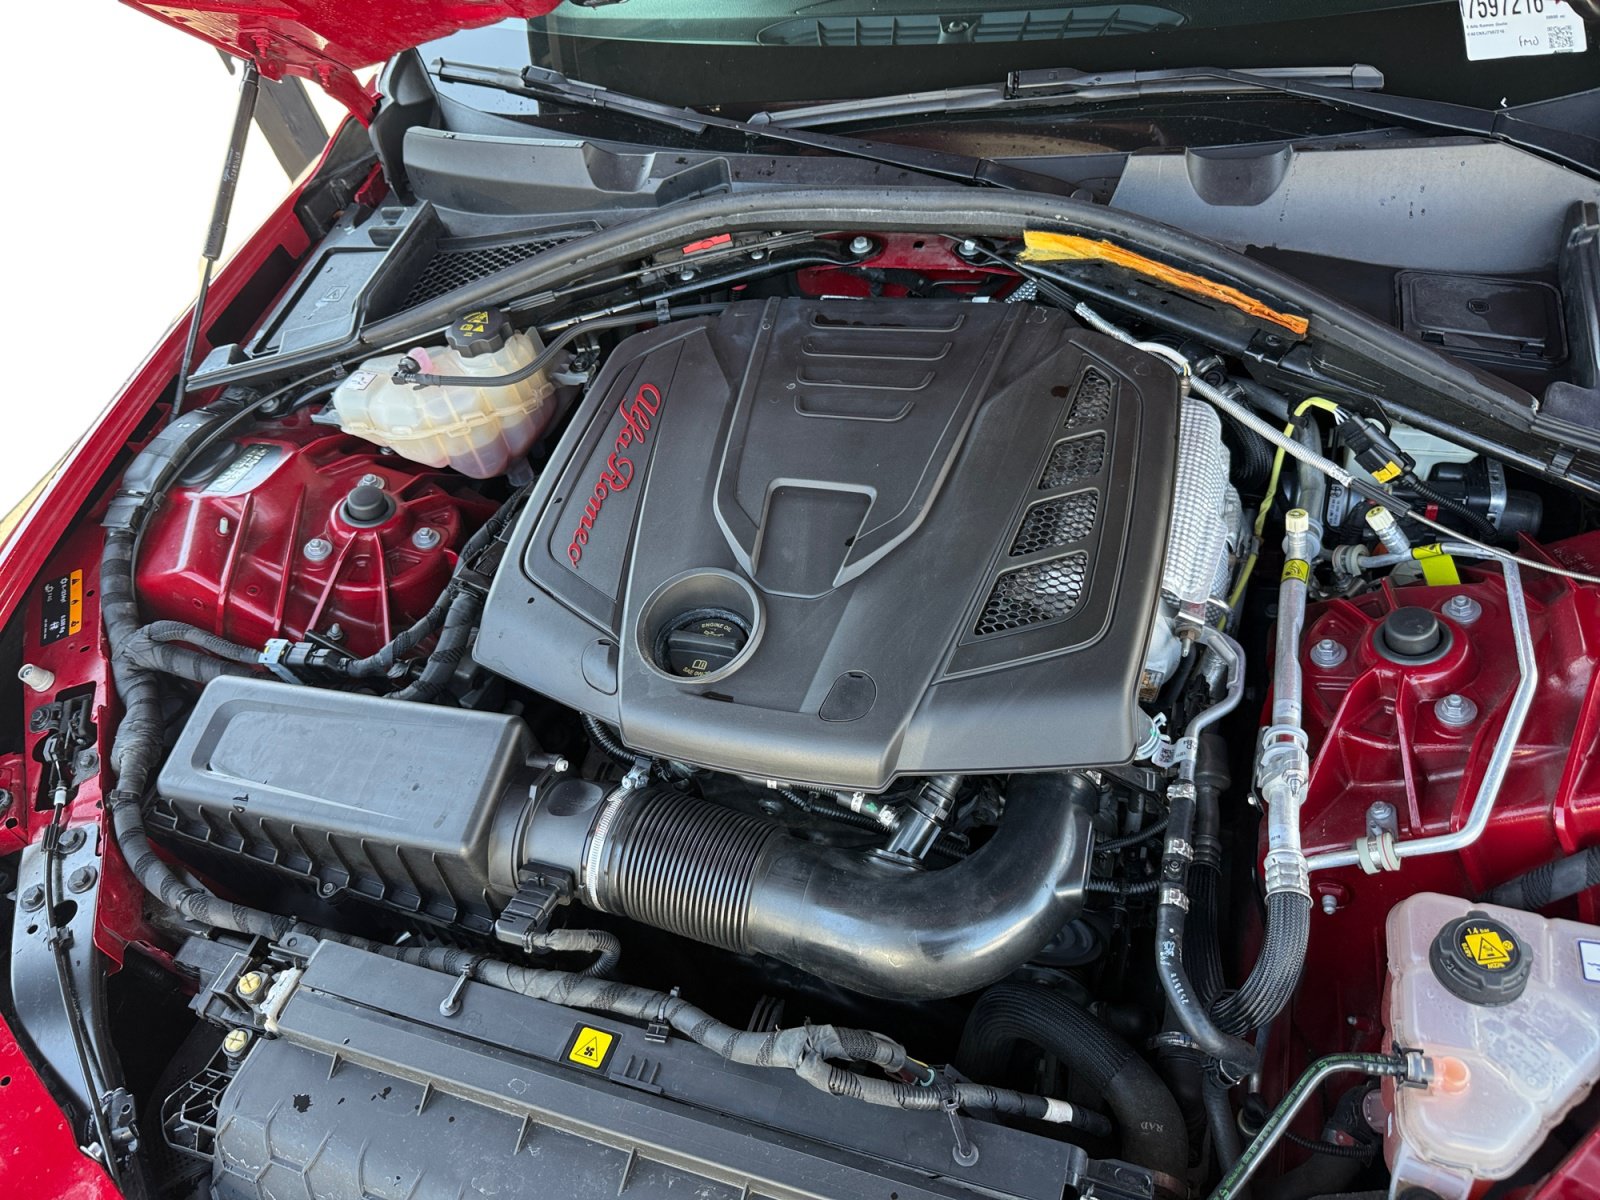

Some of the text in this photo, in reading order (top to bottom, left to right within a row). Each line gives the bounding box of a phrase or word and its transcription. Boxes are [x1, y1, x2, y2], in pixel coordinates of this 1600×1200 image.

[567, 383, 661, 569] Alfa Romeo
[723, 625, 732, 633] OIL
[1141, 1121, 1164, 1132] RAD
